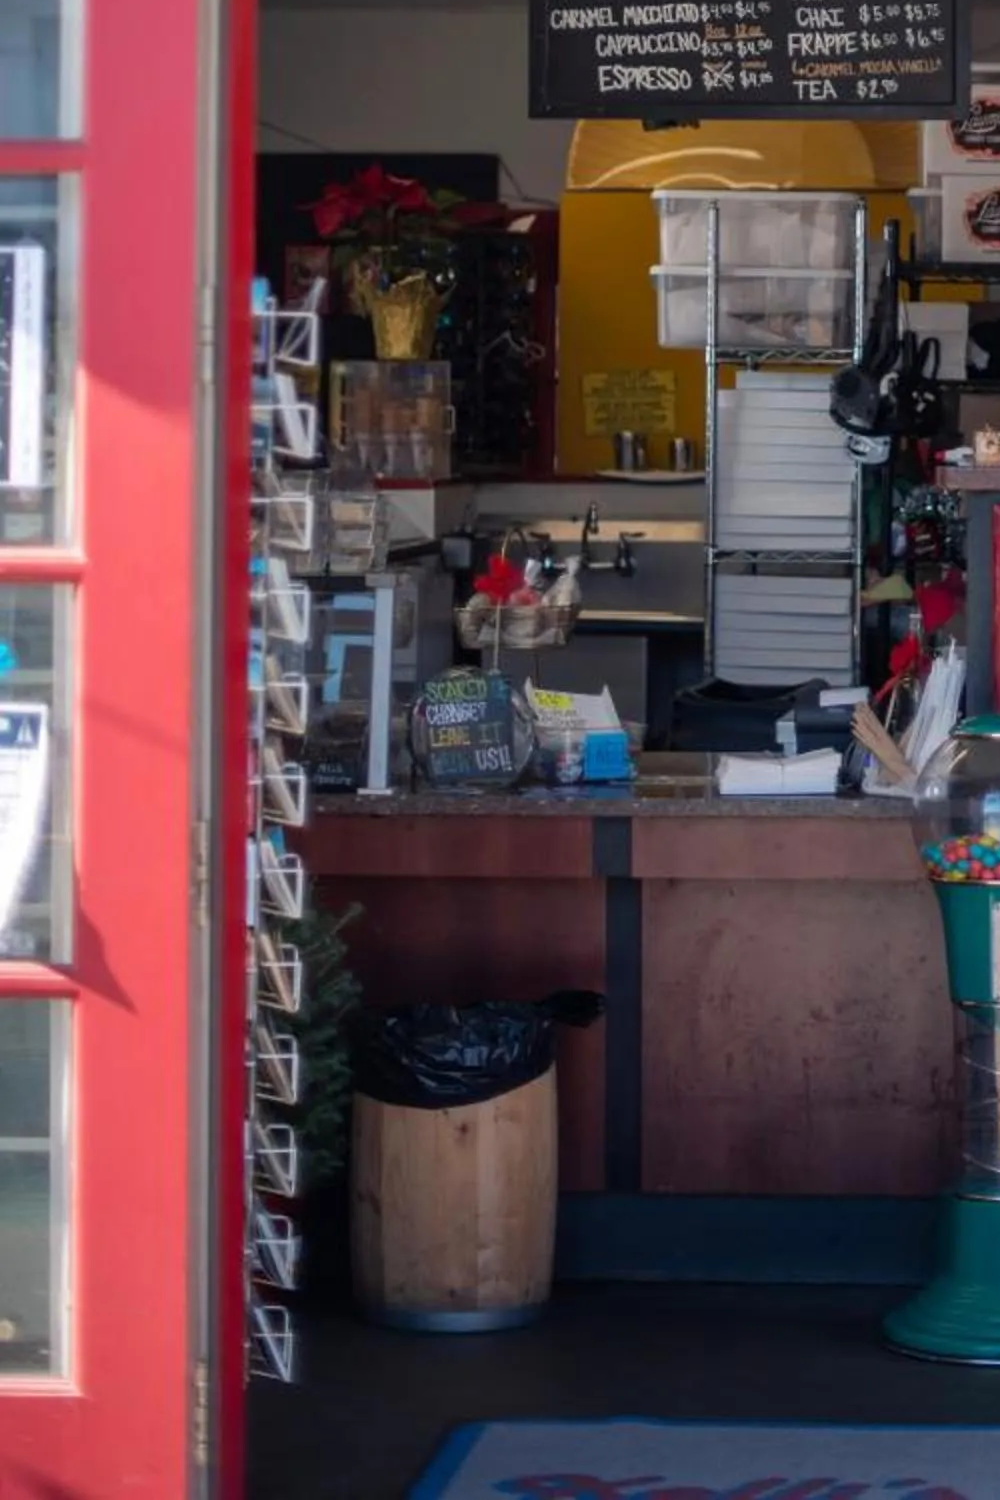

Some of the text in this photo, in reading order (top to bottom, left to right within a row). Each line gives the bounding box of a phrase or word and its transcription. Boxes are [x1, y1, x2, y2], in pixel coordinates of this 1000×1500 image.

[550, 7, 619, 30] CARAMEL
[796, 7, 845, 28] CHAI
[595, 31, 701, 57] CAPPUCCINO
[788, 31, 858, 57] FRAPPE
[598, 64, 693, 92] ESPRESSO
[792, 79, 838, 100] TEA
